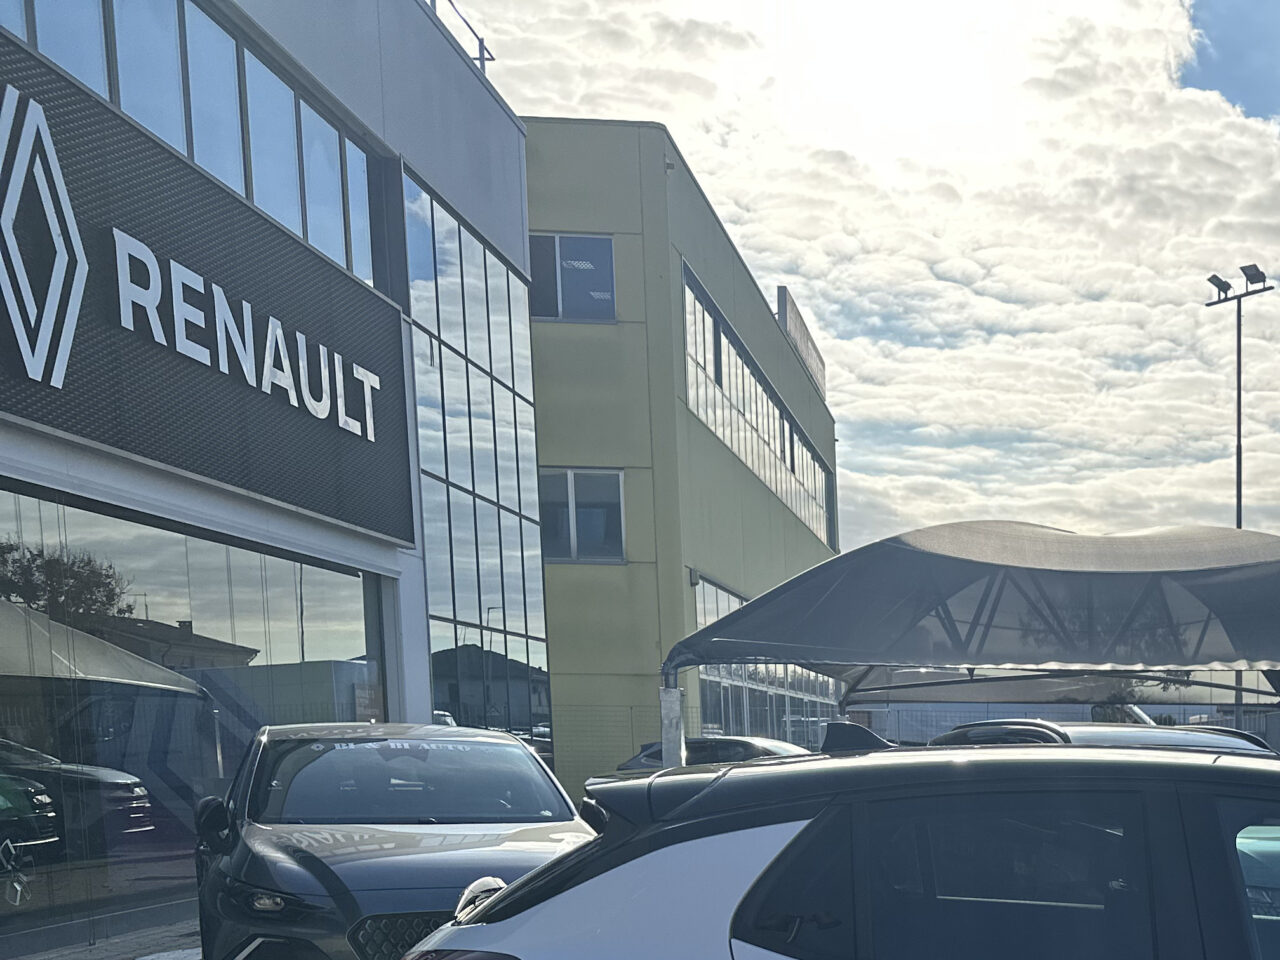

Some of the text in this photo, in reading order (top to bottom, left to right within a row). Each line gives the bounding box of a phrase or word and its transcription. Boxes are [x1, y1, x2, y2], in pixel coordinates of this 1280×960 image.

[112, 227, 381, 443] RENAULT
[334, 742, 356, 750] BI
[418, 743, 471, 752] AUTO
